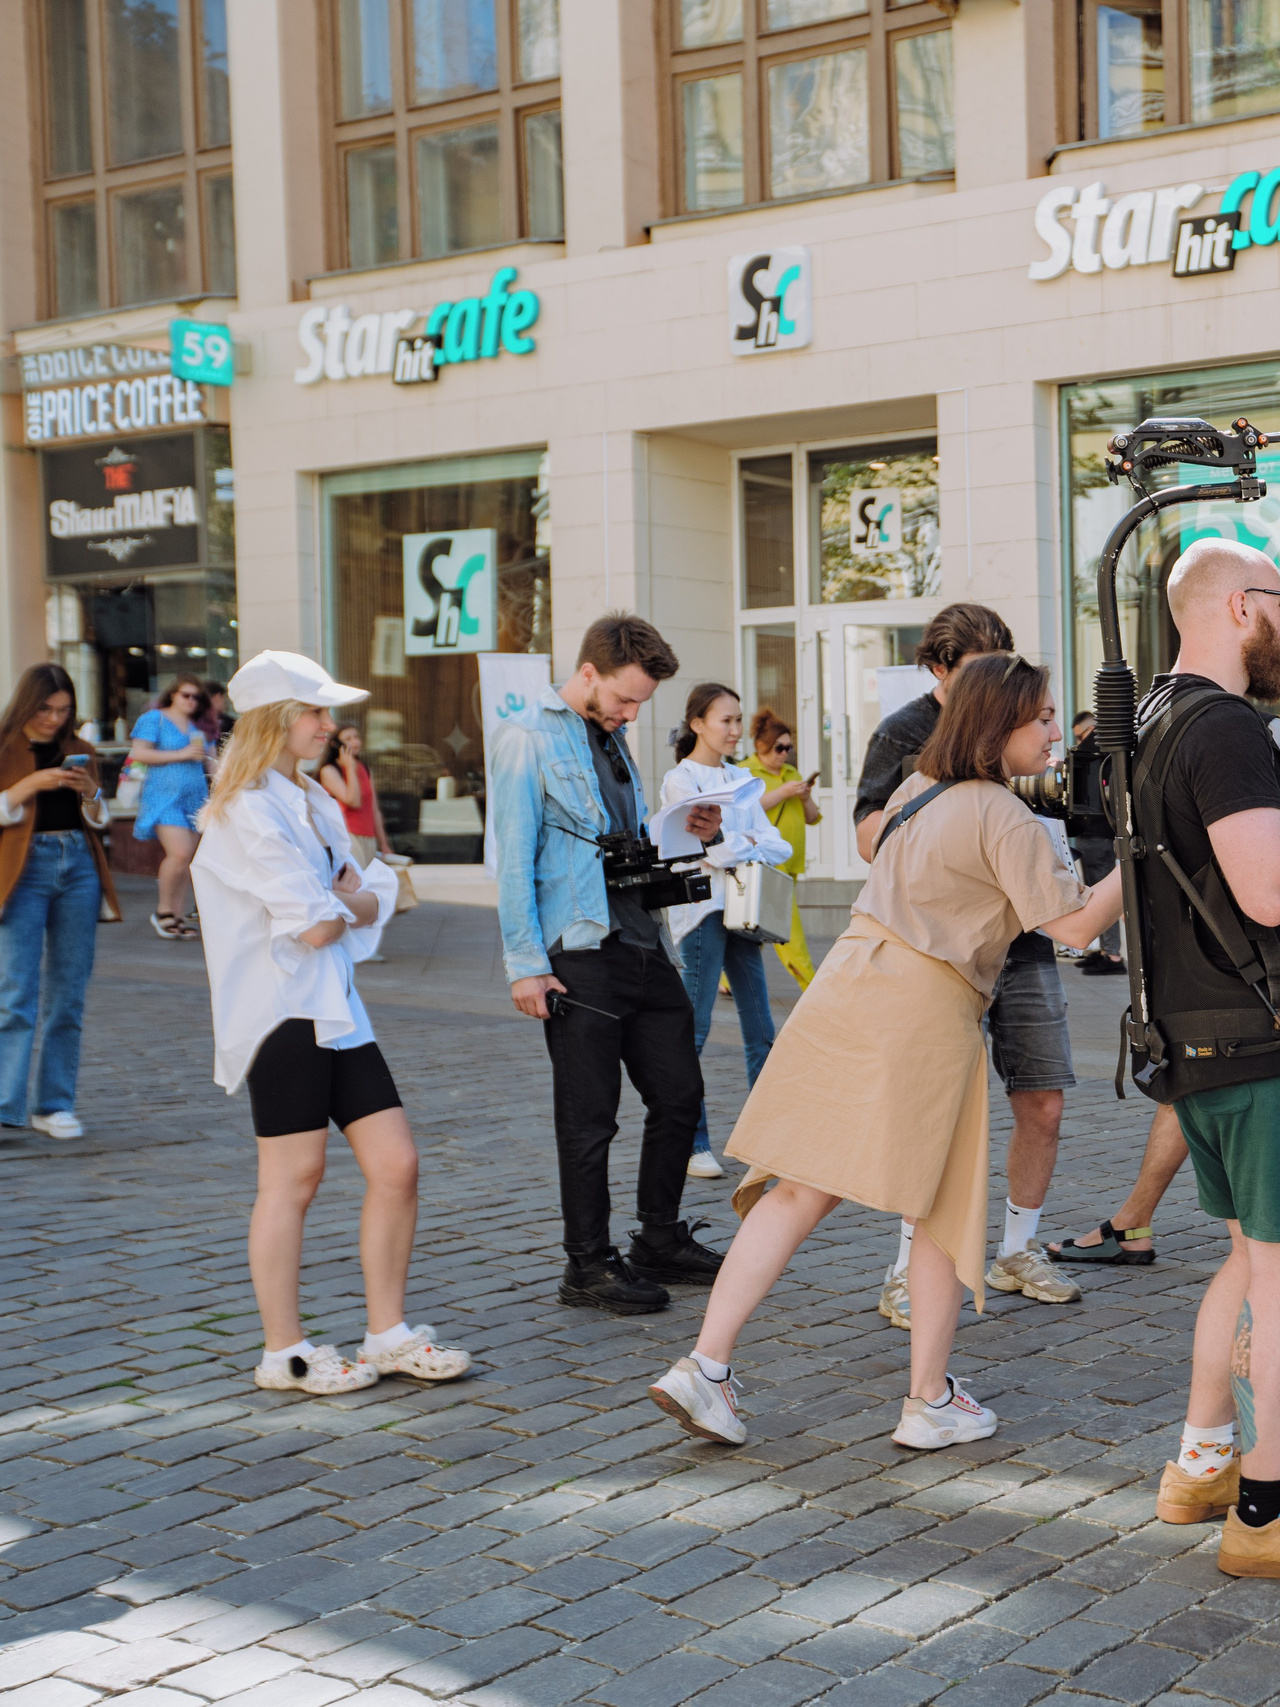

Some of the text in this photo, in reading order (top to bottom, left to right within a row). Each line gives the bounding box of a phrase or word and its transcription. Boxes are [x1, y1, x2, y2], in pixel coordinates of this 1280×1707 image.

[1028, 181, 1204, 281] Star
[1174, 217, 1235, 276] hit
[181, 331, 229, 369] 59
[294, 267, 540, 386] Star hit cafe
[26, 374, 203, 440] ONE PRICE COFFEE
